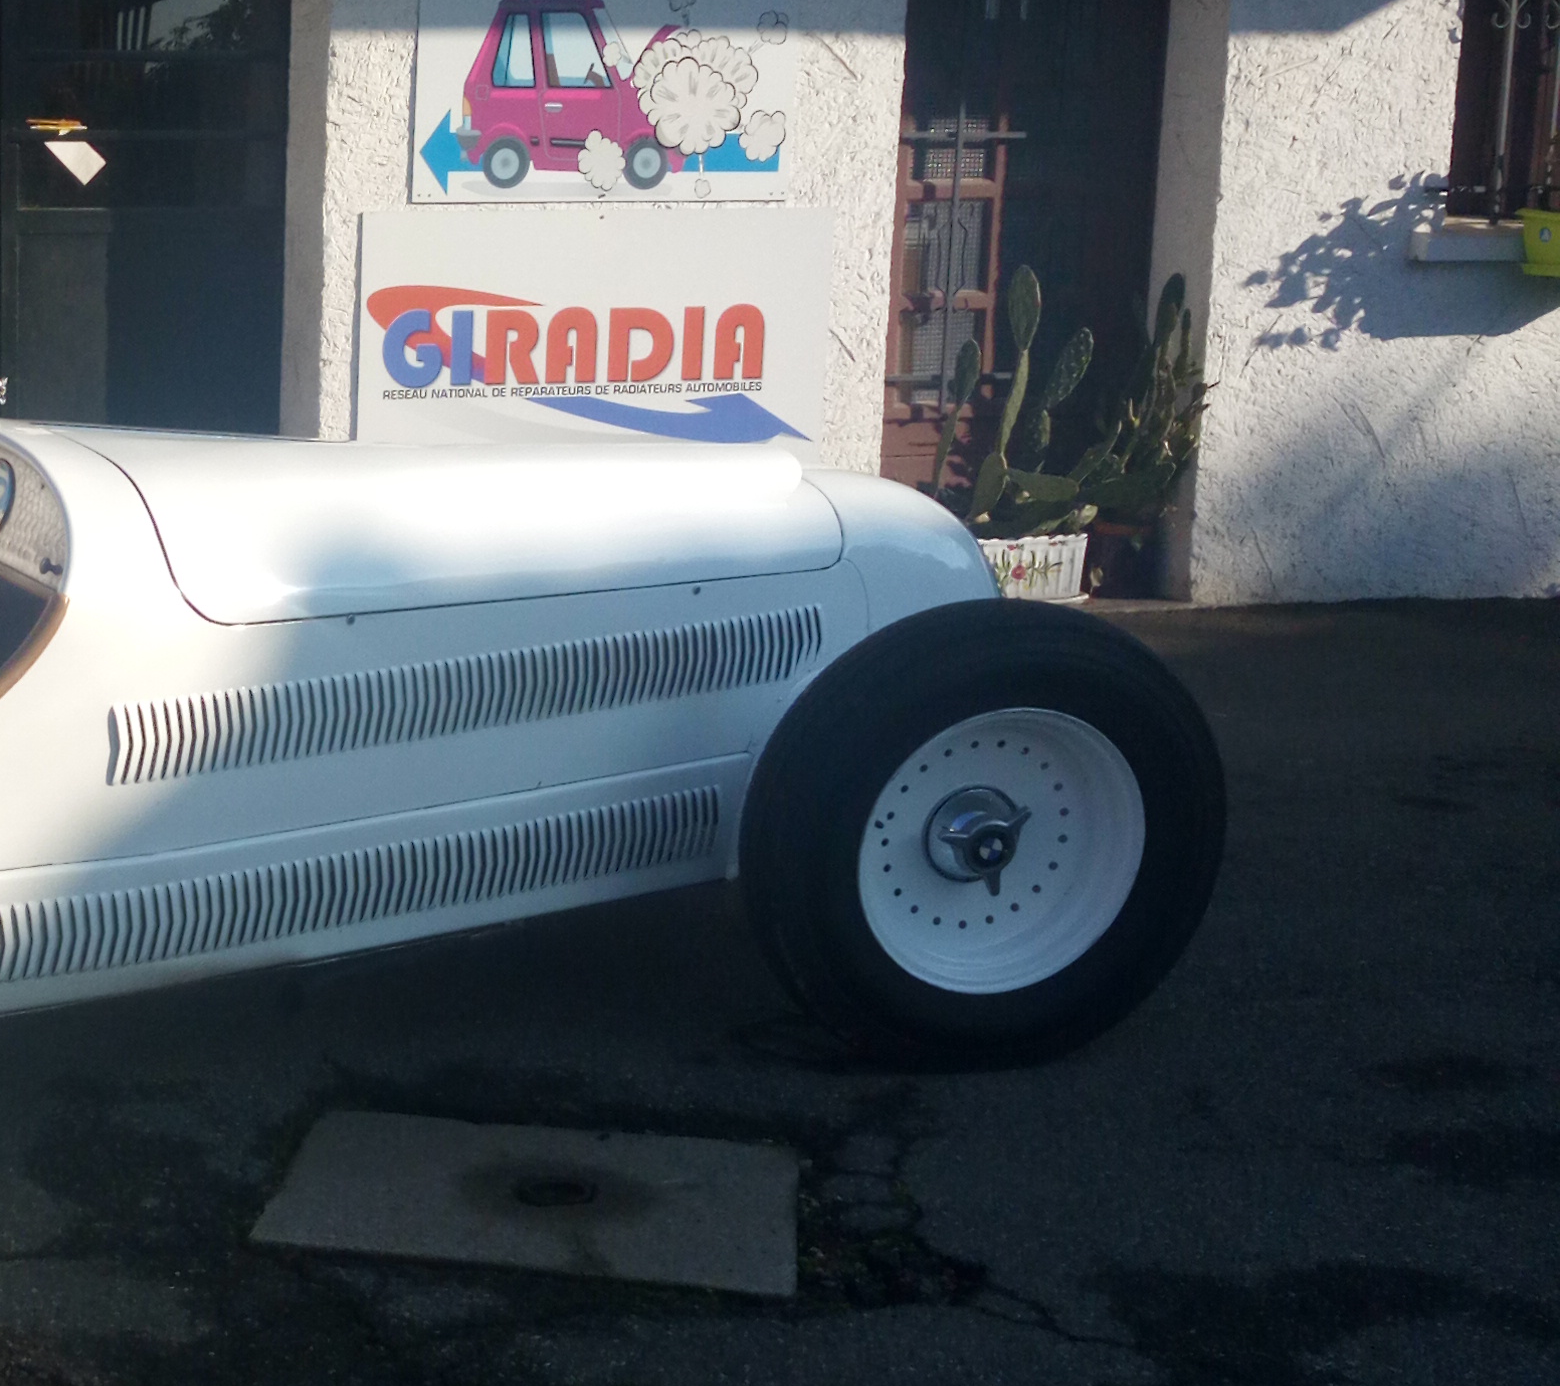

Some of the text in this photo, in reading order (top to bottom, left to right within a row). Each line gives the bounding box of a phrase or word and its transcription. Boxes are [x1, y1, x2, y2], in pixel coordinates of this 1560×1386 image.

[382, 302, 765, 387] GIRADIA
[383, 381, 762, 400] RESEAU NATIONAL DE REPARATEURS DE RADIATEURS AUTOMOBILES
